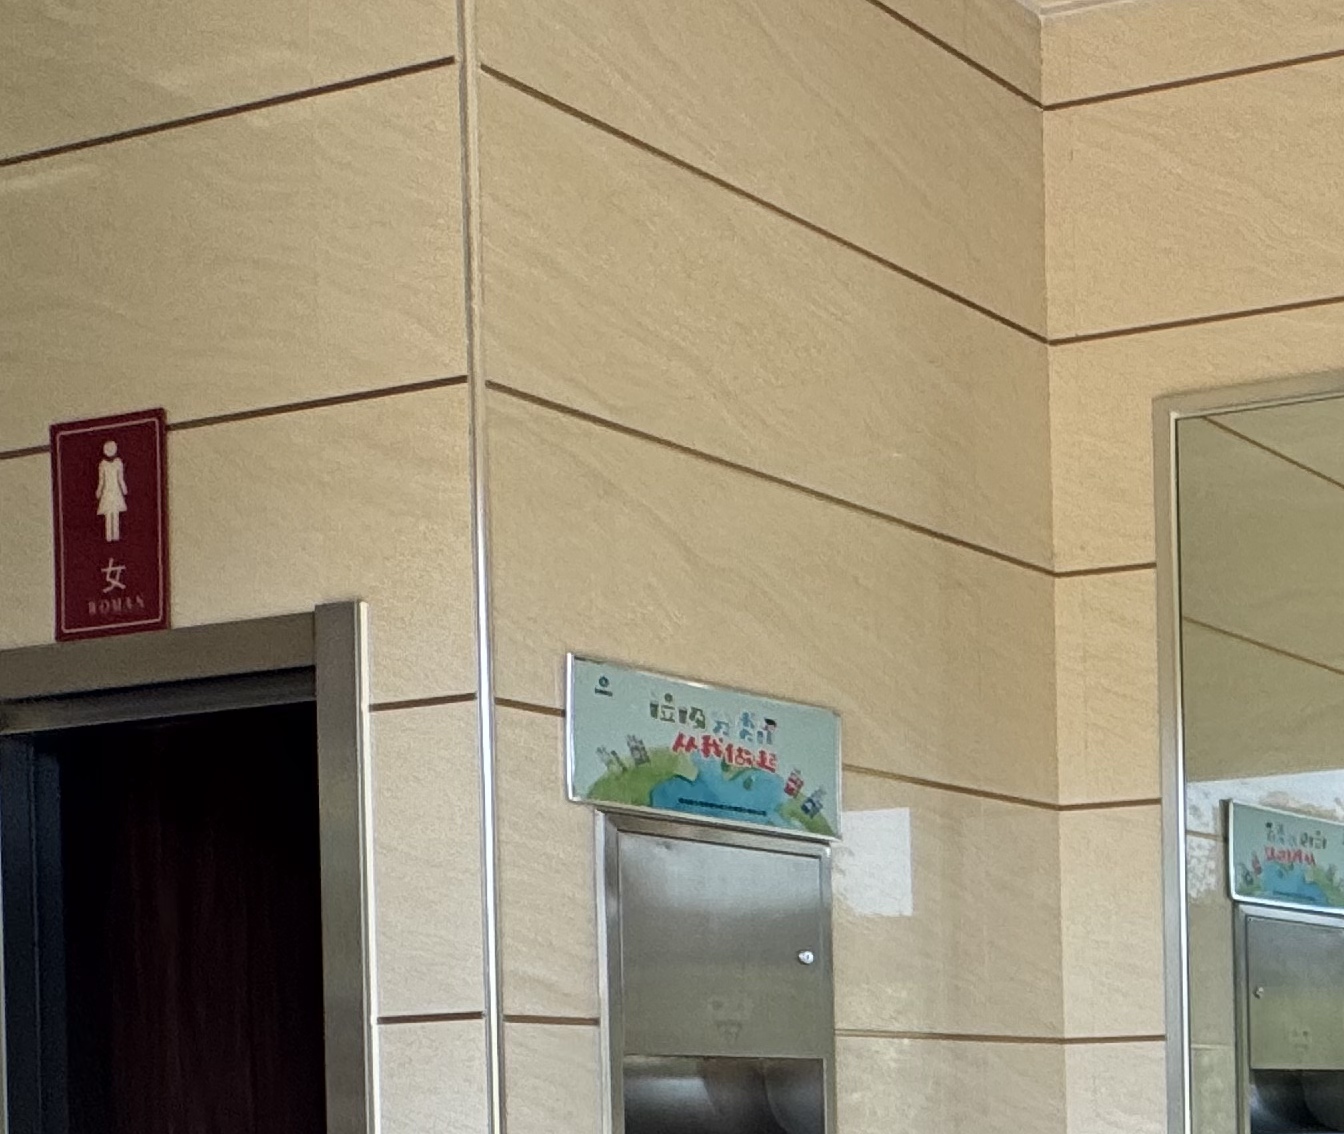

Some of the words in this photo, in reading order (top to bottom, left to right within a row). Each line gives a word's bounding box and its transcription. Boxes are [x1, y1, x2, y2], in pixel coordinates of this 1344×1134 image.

[101, 557, 126, 593] 女
[672, 731, 778, 773] 从我做起
